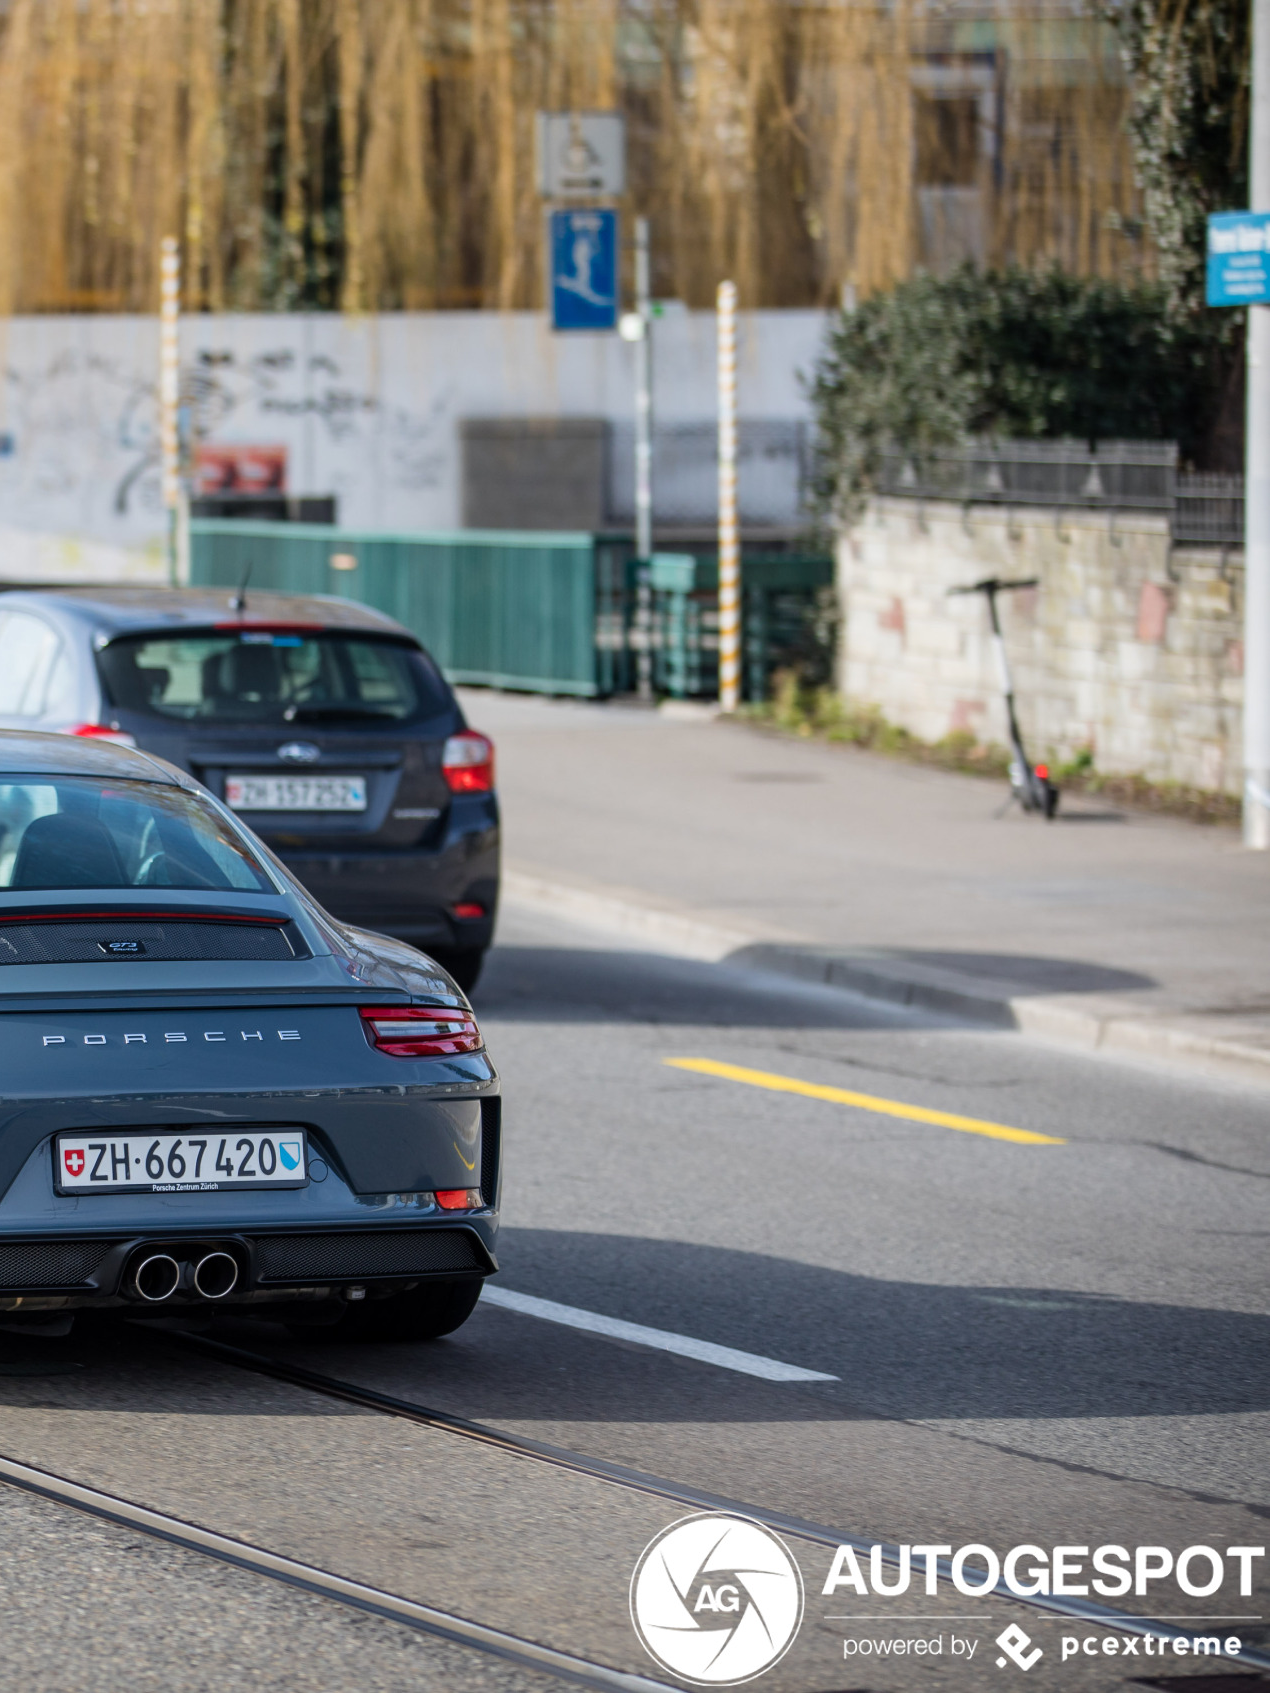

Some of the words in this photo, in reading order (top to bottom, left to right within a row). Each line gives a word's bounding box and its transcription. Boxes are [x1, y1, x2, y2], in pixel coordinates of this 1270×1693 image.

[43, 1030, 301, 1046] PORSCHE
[176, 1183, 199, 1191] Zentrum
[200, 1182, 219, 1190] Zürich
